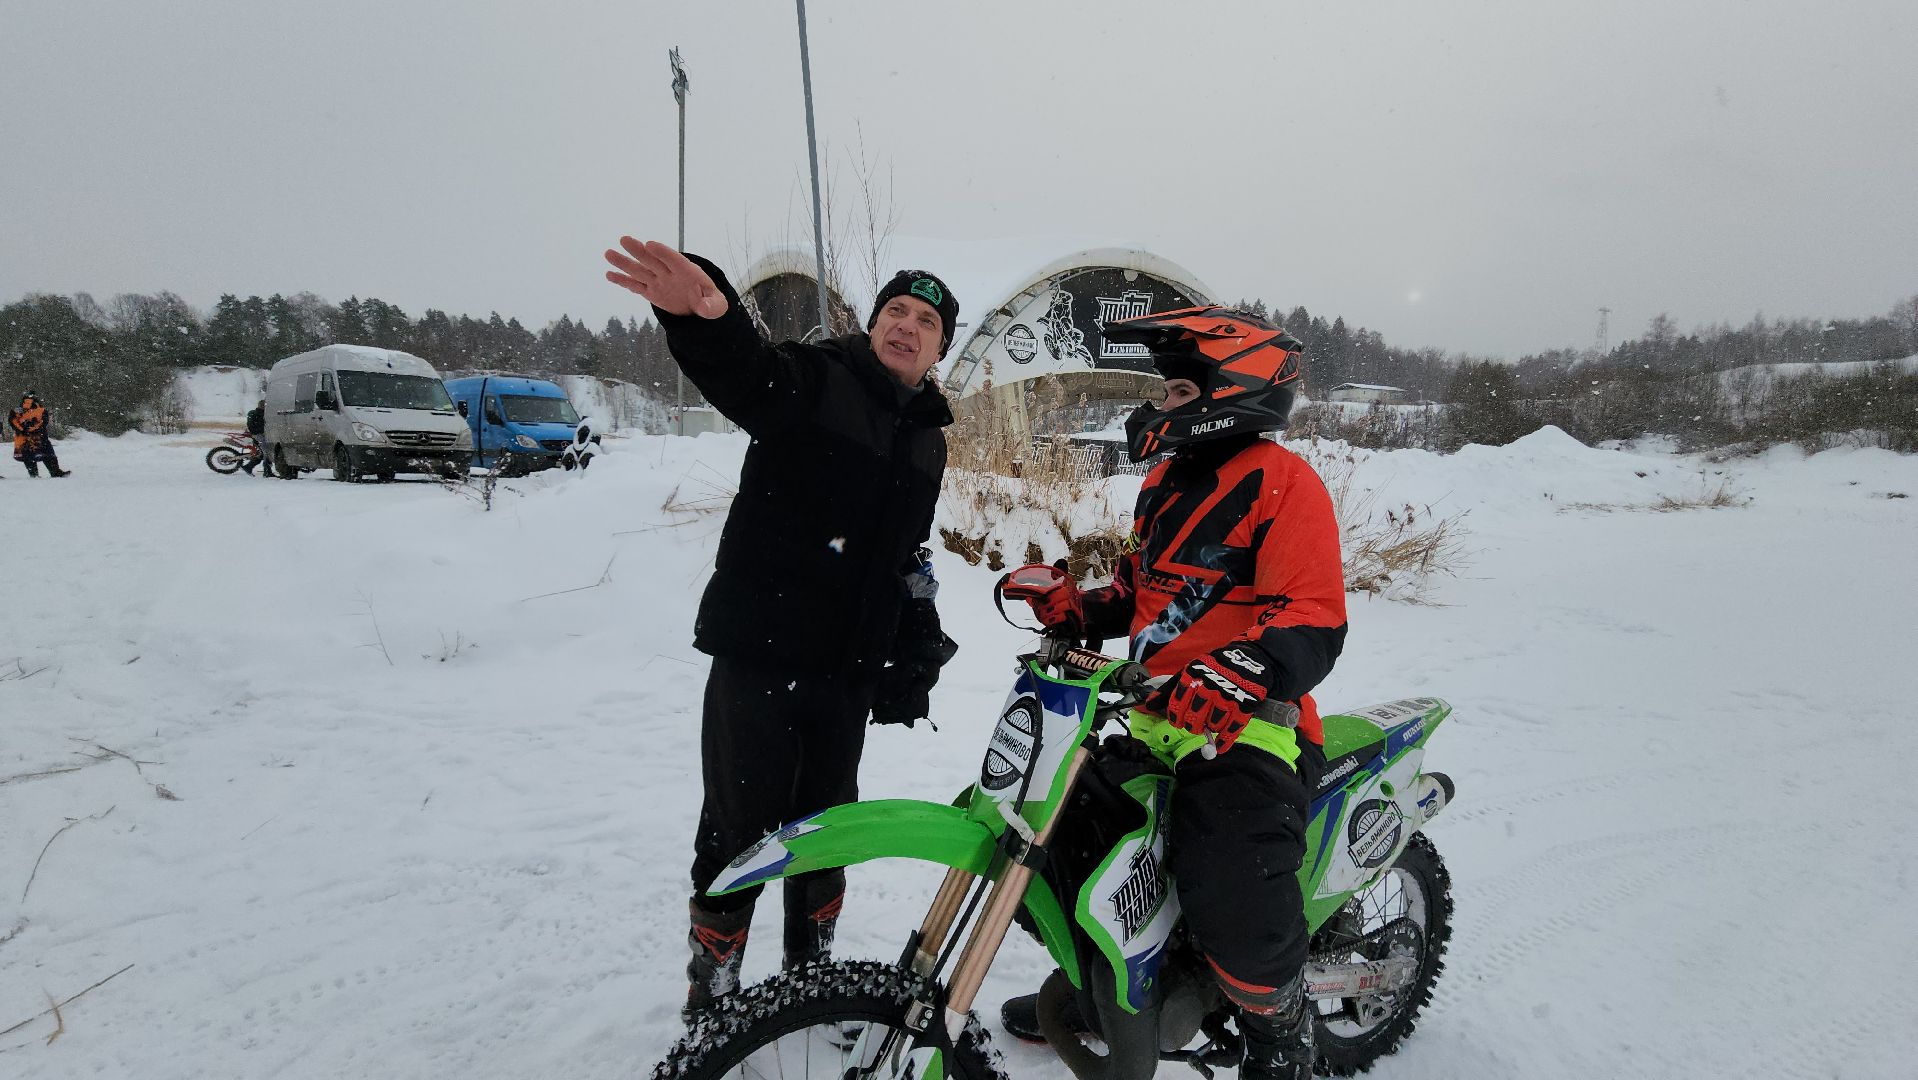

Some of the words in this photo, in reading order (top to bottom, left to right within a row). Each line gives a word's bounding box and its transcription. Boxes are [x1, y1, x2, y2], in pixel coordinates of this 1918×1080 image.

[1191, 416, 1234, 435] RACING
[1191, 664, 1258, 703] FOX
[1356, 812, 1396, 858] ВЕЛЬЯМИНОВО
